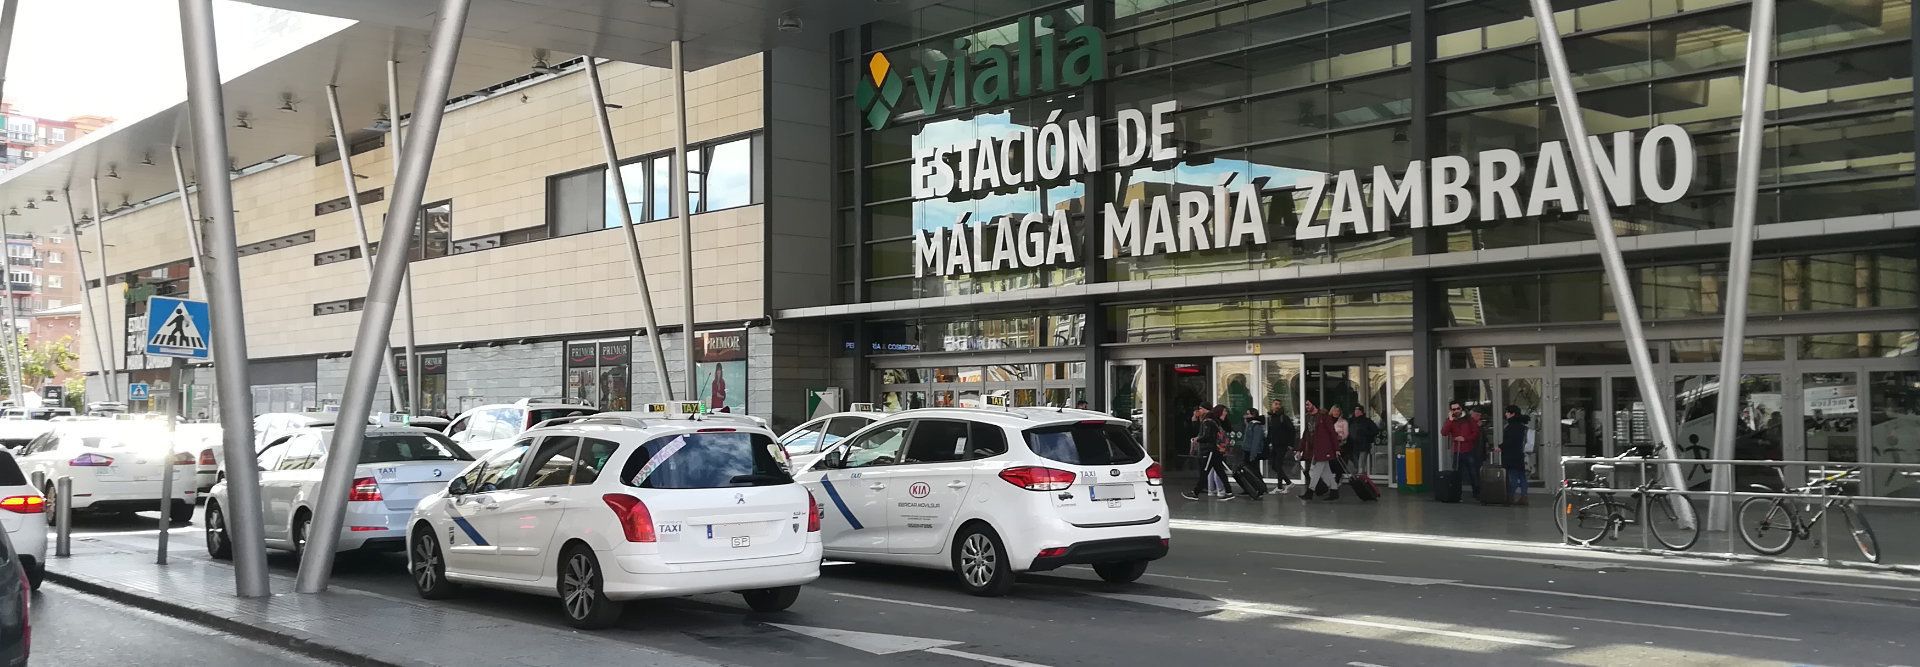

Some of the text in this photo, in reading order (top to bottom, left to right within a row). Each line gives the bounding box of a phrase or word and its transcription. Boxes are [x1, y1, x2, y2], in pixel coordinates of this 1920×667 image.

[912, 15, 1105, 116] vialia
[911, 100, 1178, 199] ESTACIÓN DE
[914, 123, 1694, 278] MÁLAGA MARÍA ZAMBRANO
[602, 344, 628, 356] PRIMOR
[705, 335, 740, 351] PRIMOR
[991, 396, 1005, 406] TAXI
[659, 524, 682, 533] TAXI
